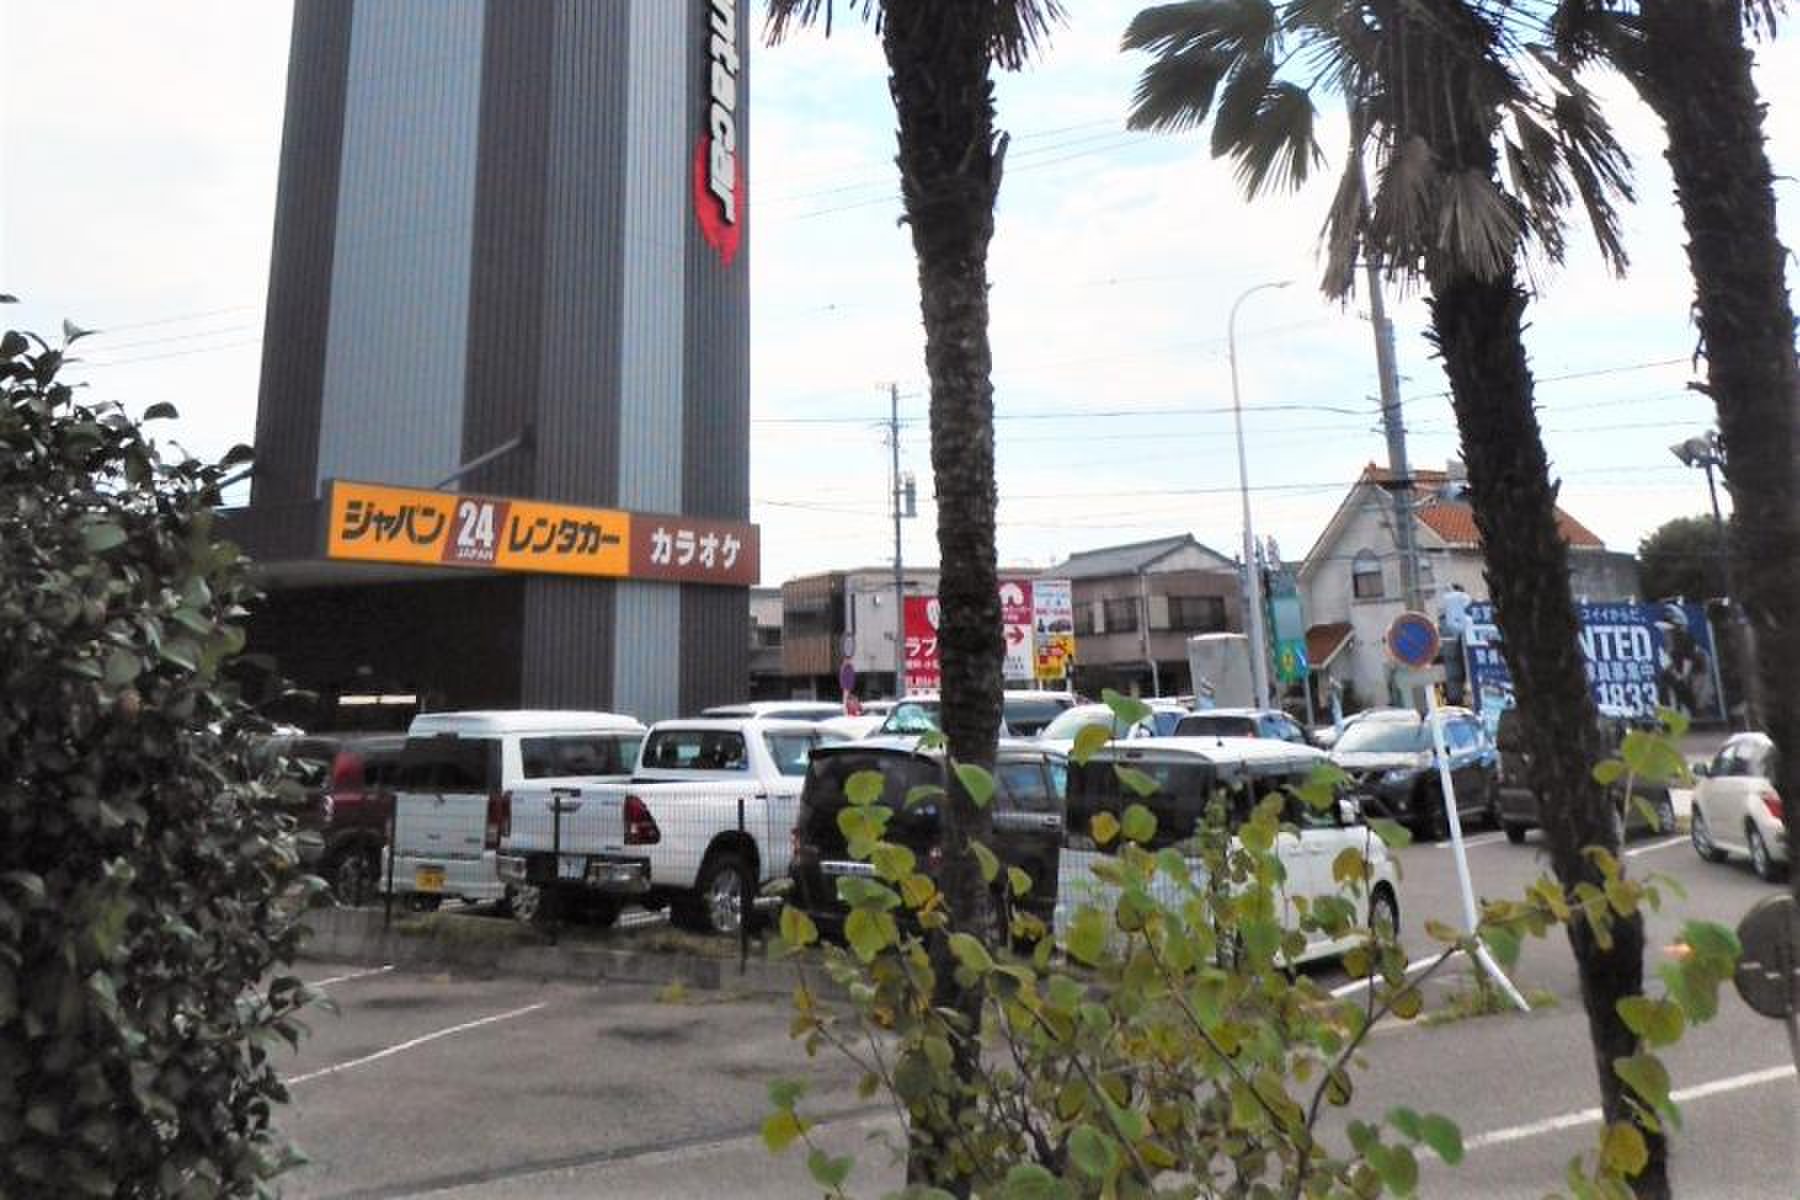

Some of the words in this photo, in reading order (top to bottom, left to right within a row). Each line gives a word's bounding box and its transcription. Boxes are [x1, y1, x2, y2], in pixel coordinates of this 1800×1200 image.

[341, 499, 447, 546] ジャパン
[457, 501, 495, 548] 24
[508, 515, 620, 555] レンタカー
[650, 527, 741, 569] カラオケ
[1577, 624, 1653, 662] NTED
